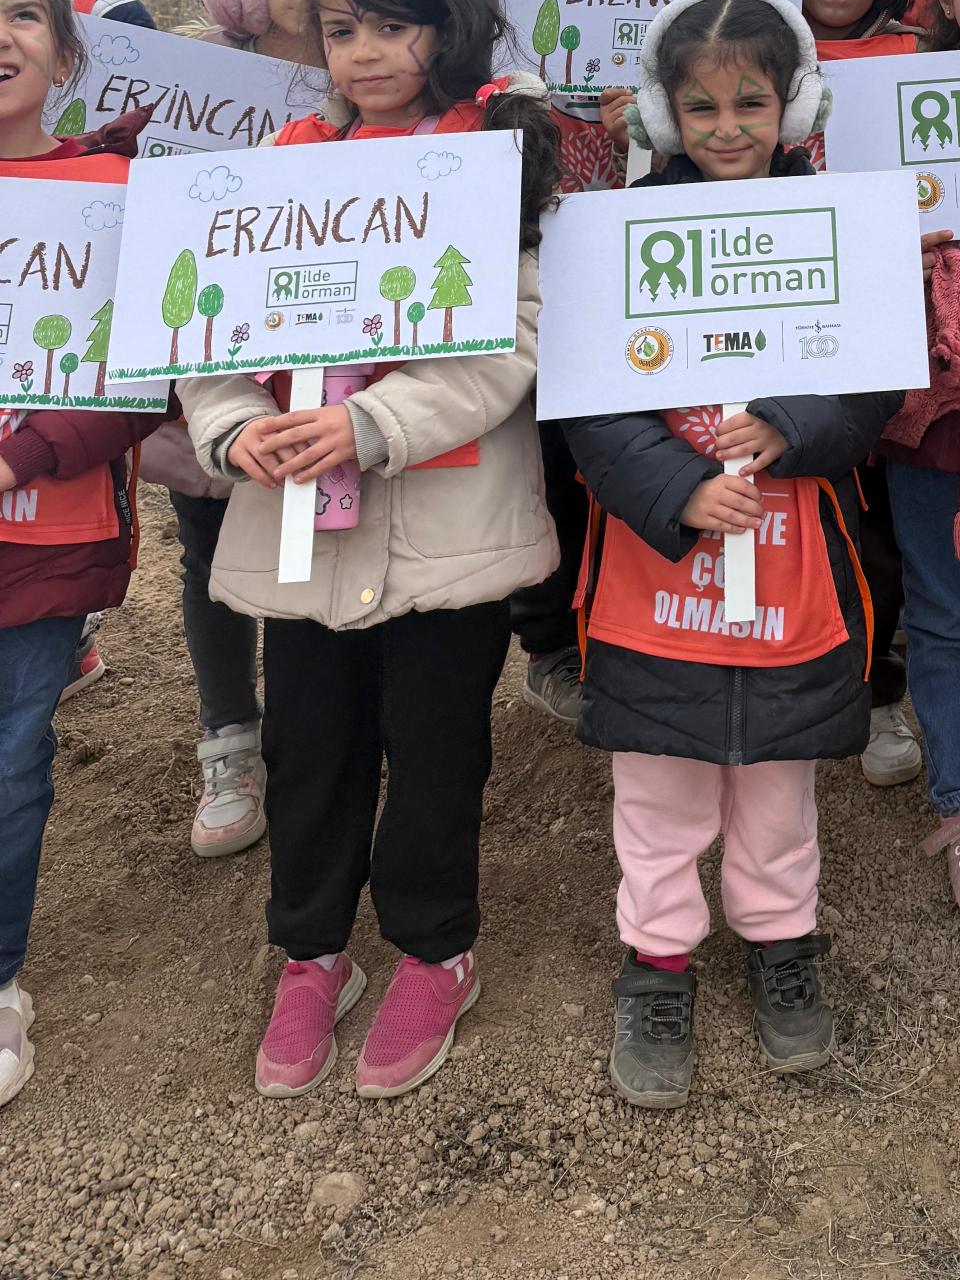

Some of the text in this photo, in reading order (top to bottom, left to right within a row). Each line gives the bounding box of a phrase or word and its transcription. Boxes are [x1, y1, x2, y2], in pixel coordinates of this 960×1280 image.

[617, 22, 639, 46] 81
[205, 191, 429, 258] ERZİNCAN
[639, 226, 774, 303] 81 ilde
[272, 269, 331, 300] 81 ilde
[301, 283, 352, 299] orman
[710, 265, 826, 297] orman
[297, 312, 318, 322] TEMA
[703, 331, 752, 353] TEMA
[799, 334, 840, 360] 100
